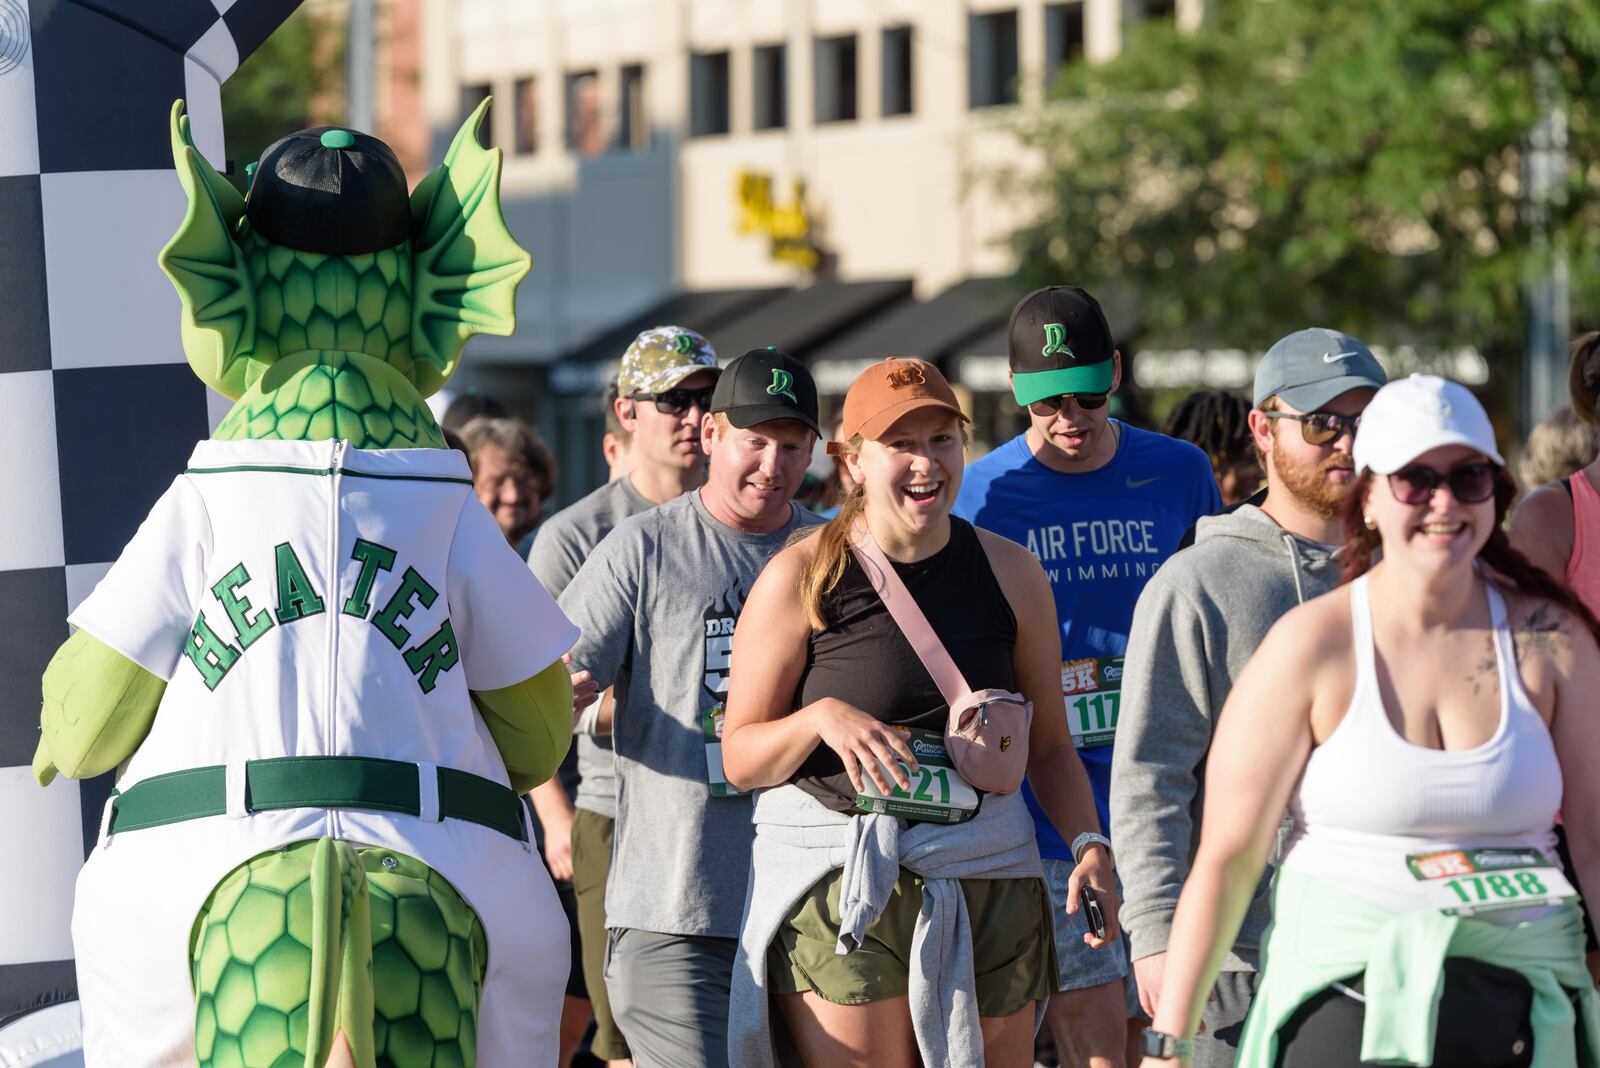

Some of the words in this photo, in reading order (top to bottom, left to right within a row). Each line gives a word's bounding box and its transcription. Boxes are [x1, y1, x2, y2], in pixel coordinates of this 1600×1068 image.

[1027, 525, 1067, 561] AIR
[1072, 520, 1158, 557] FORCE
[182, 537, 459, 694] HEATER
[1062, 667, 1096, 692] 5K
[1073, 692, 1120, 731] 117
[1443, 872, 1547, 902] 1788
